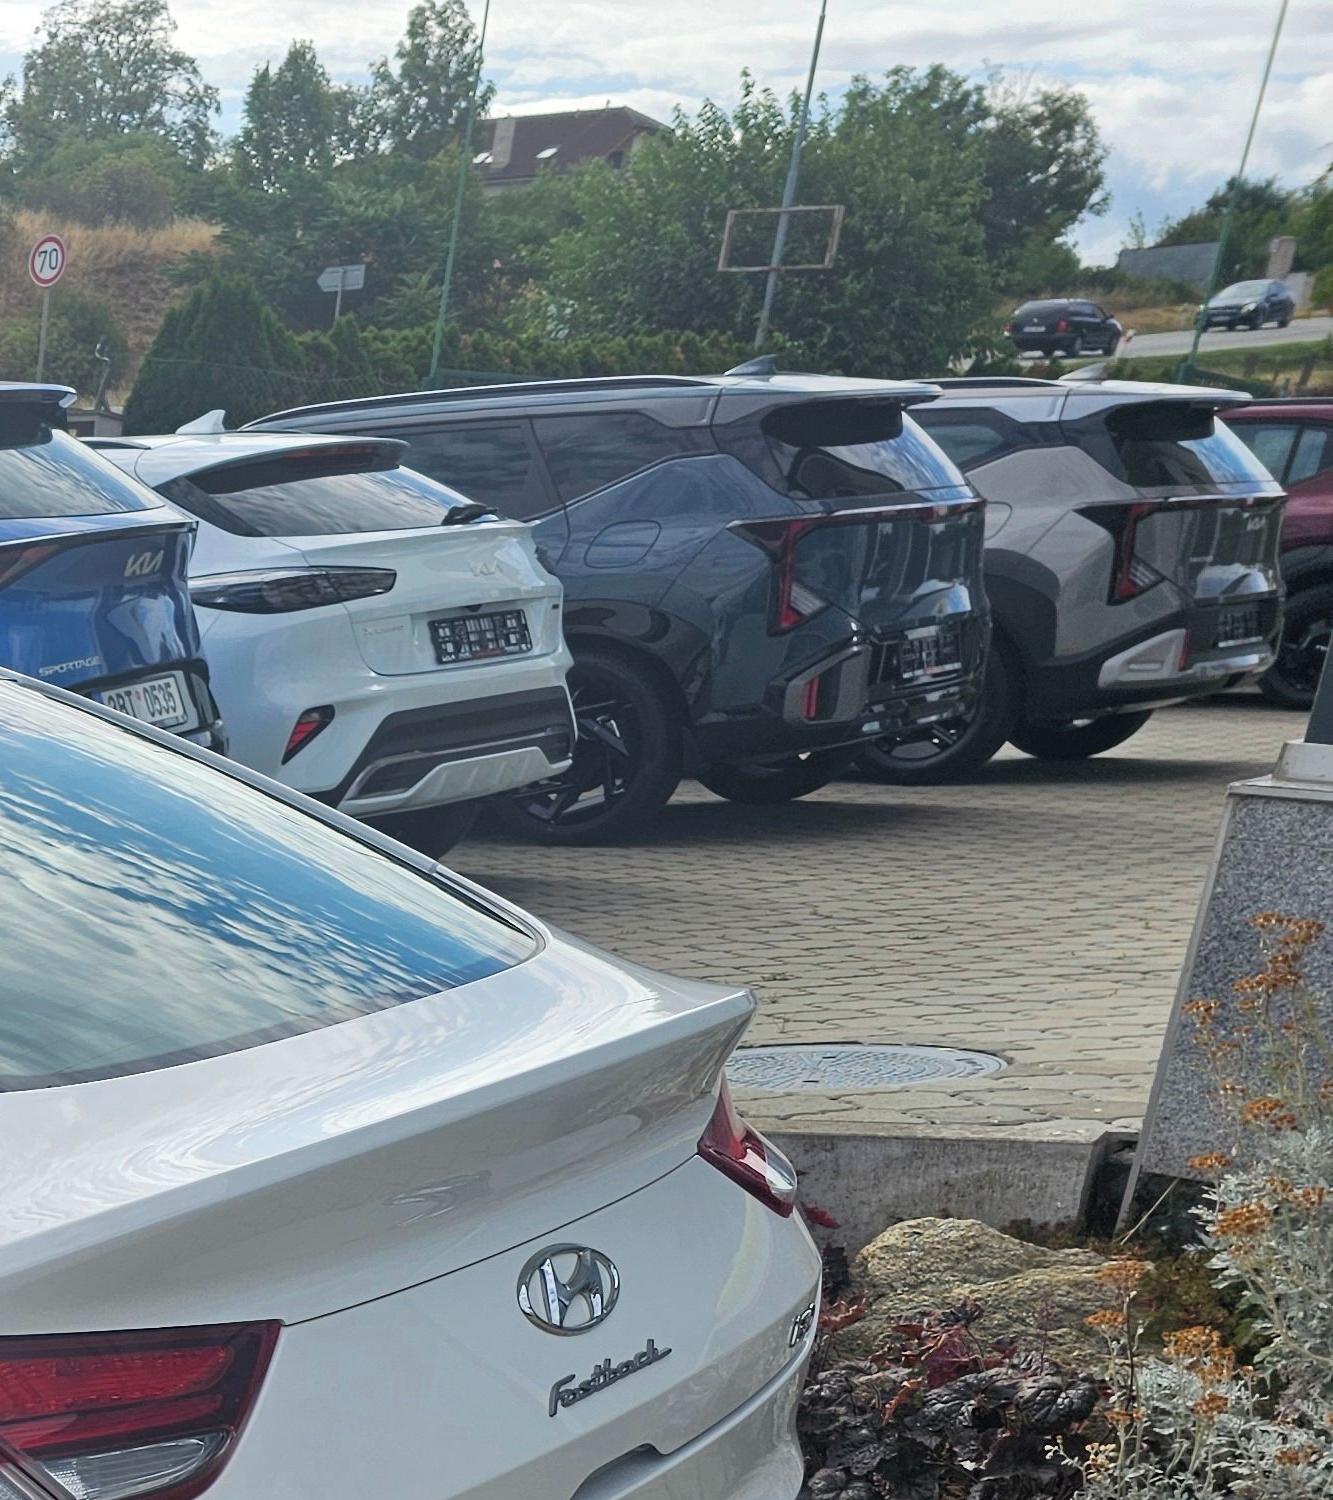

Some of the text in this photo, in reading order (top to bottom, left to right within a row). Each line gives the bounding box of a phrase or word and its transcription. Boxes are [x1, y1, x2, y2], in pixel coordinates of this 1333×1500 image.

[38, 248, 58, 273] 70
[124, 550, 165, 577] KIA
[38, 656, 103, 677] SPORTAGE
[548, 1338, 673, 1418] Fastback
